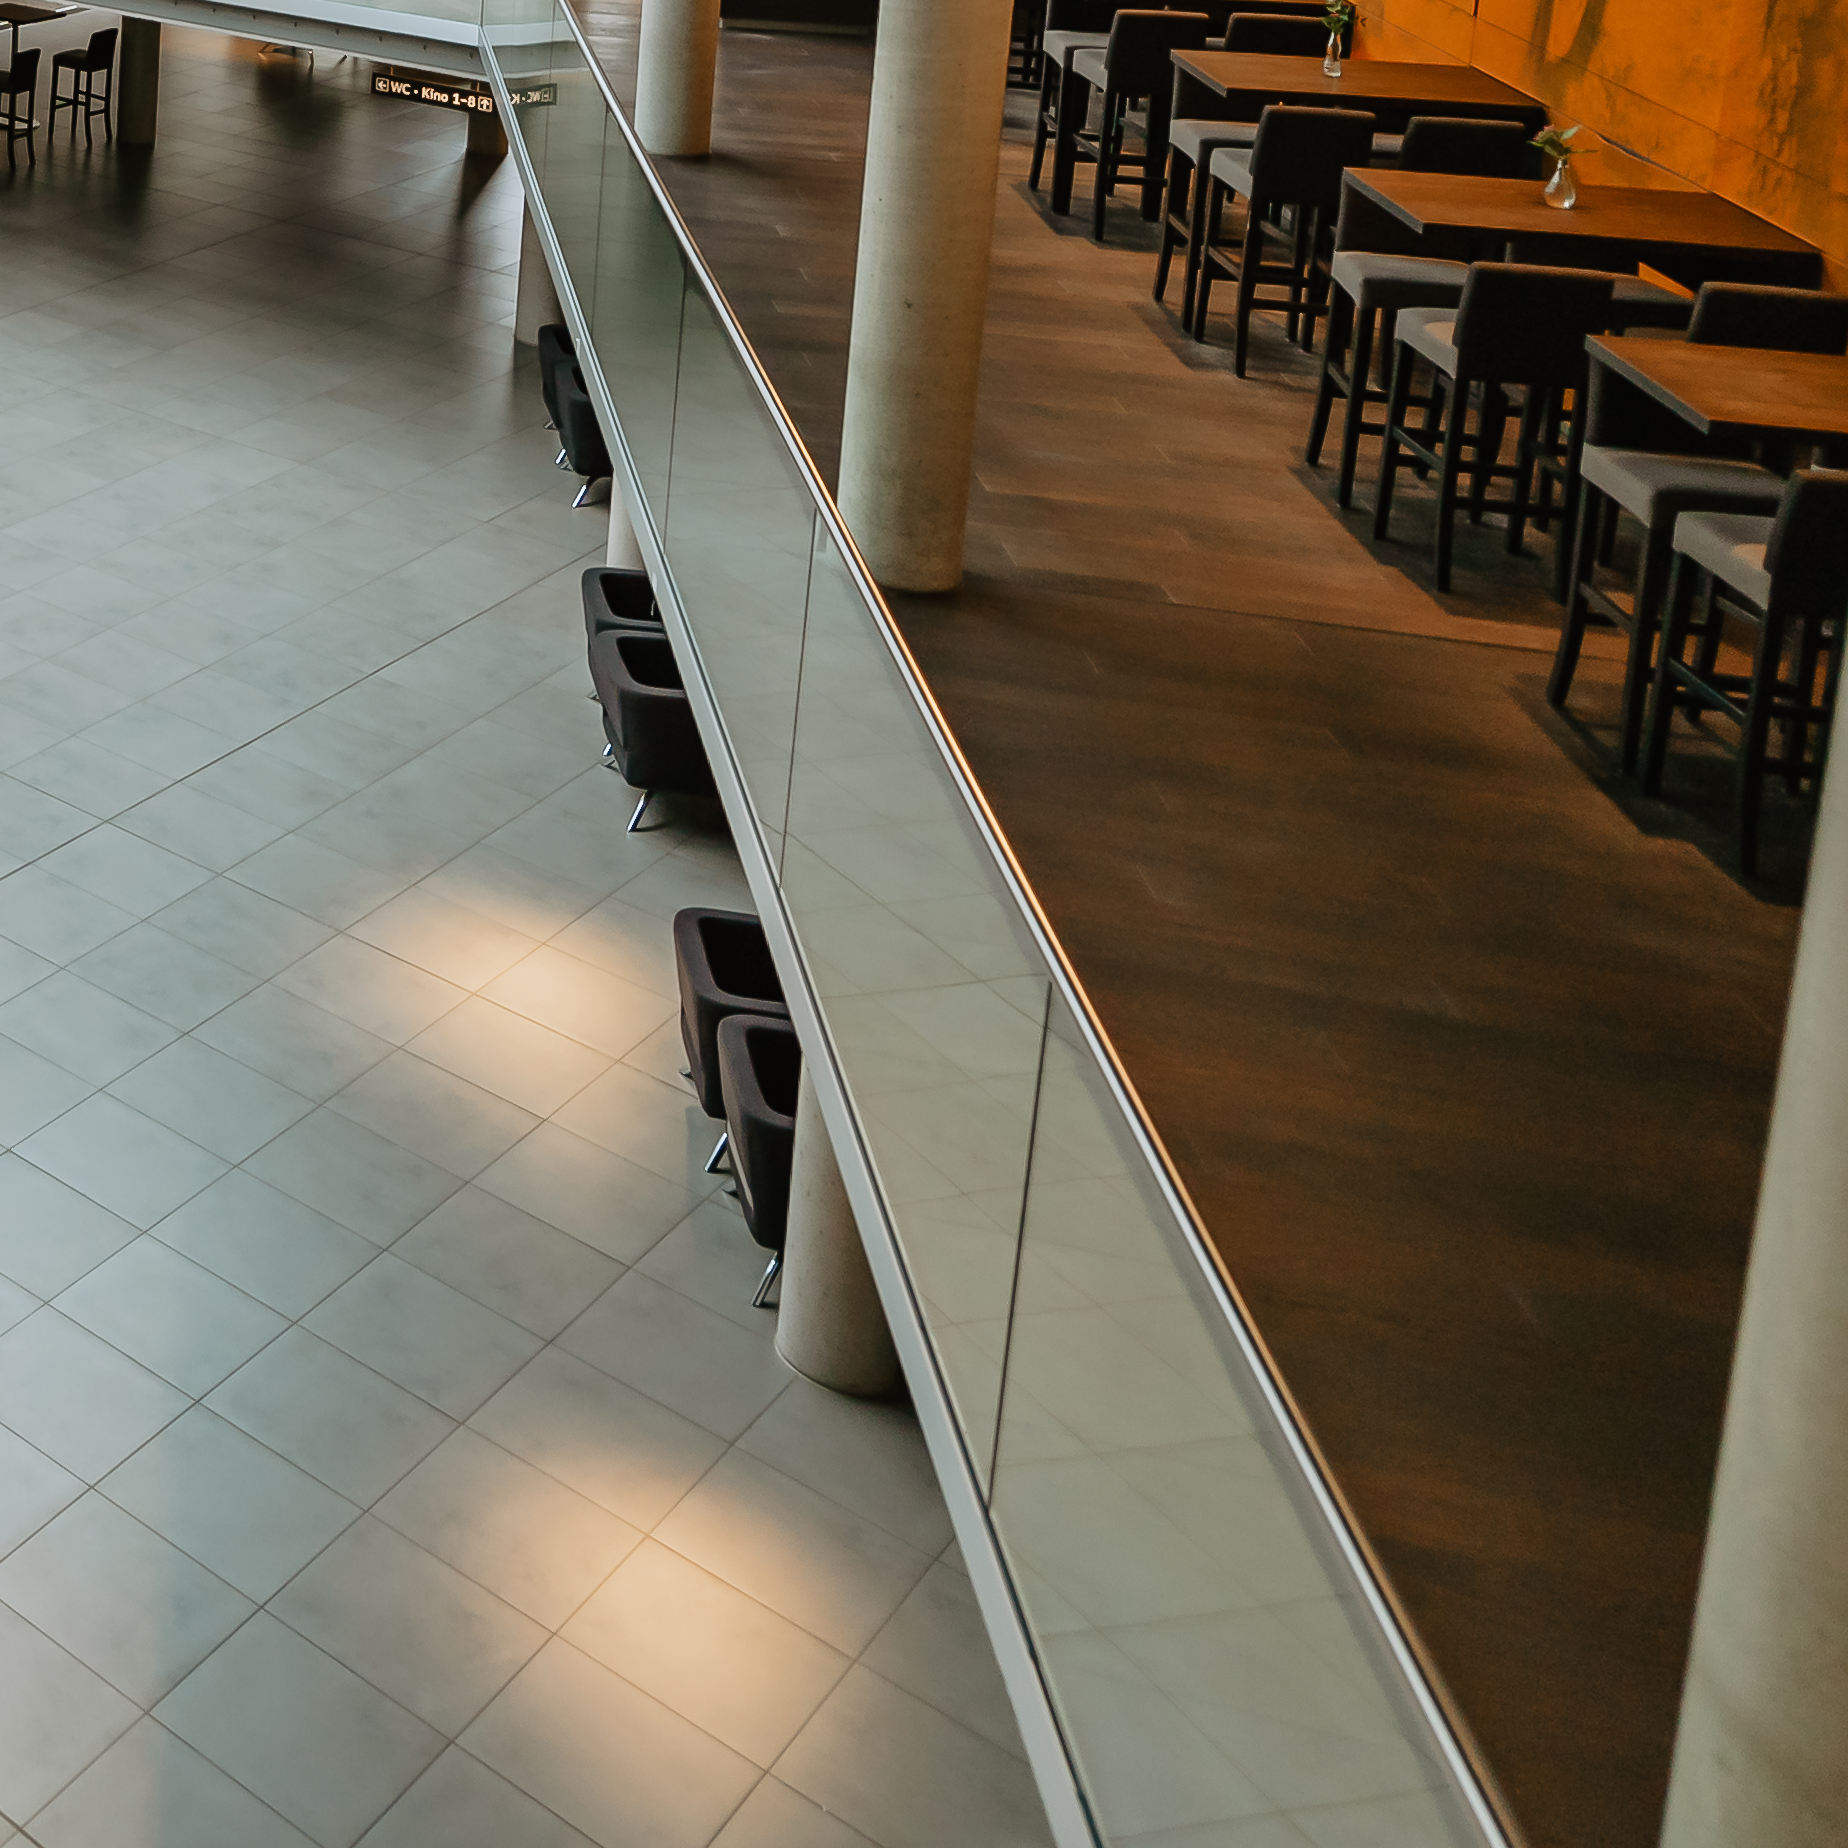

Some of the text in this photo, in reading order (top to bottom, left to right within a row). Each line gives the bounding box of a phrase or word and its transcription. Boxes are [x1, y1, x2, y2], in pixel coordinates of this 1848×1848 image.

[391, 81, 476, 108] WC Kino 1-8
